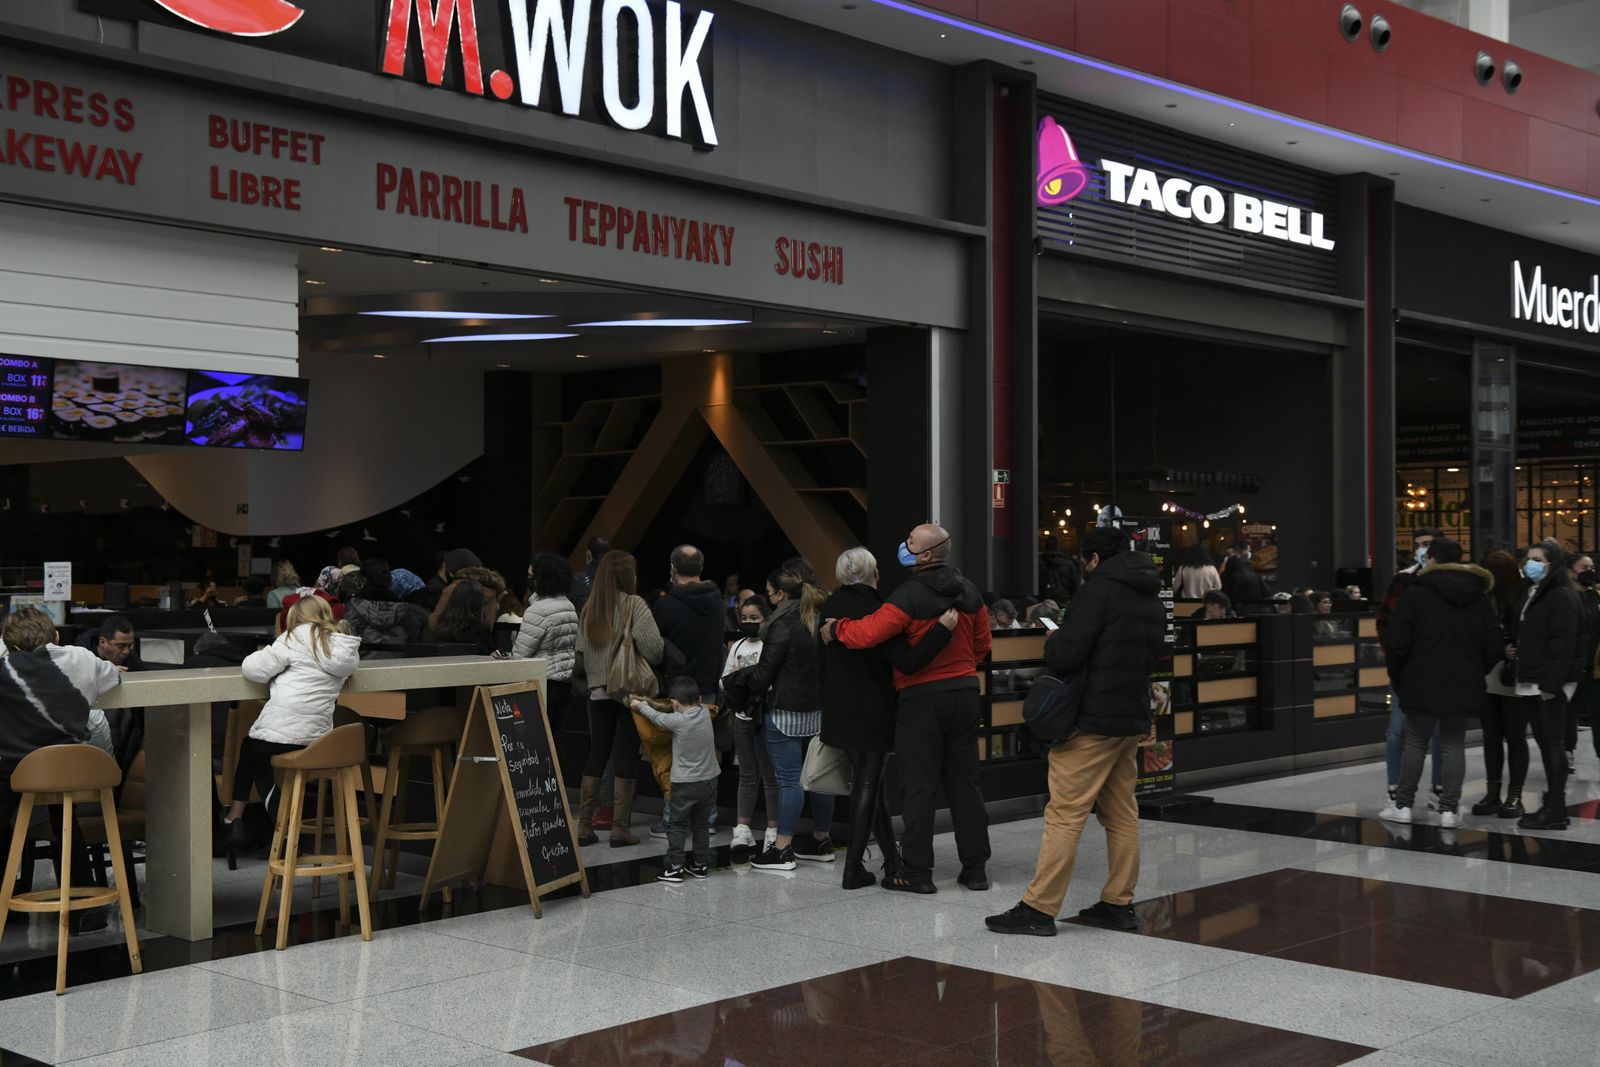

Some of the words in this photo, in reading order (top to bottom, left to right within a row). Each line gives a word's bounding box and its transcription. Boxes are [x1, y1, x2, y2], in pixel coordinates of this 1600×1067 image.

[383, 0, 718, 146] M.WOK
[0, 73, 135, 132] PRESS
[0, 128, 143, 185] KEWAY
[208, 114, 325, 166] BUFFET
[210, 166, 302, 212] LIBRE
[1101, 159, 1225, 224] TACO
[1233, 193, 1335, 250] BELL
[376, 162, 529, 234] PARRILLA
[564, 197, 735, 267] TEPPANYAKY
[774, 236, 844, 285] SUSHI
[1513, 260, 1600, 333] Muerd
[7, 373, 26, 383] BOX
[32, 361, 38, 369] A
[3, 407, 22, 416] BOX
[29, 395, 36, 403] B
[8, 425, 36, 433] BEBIDA
[495, 698, 513, 715] Nota
[508, 749, 540, 775] Seguridad
